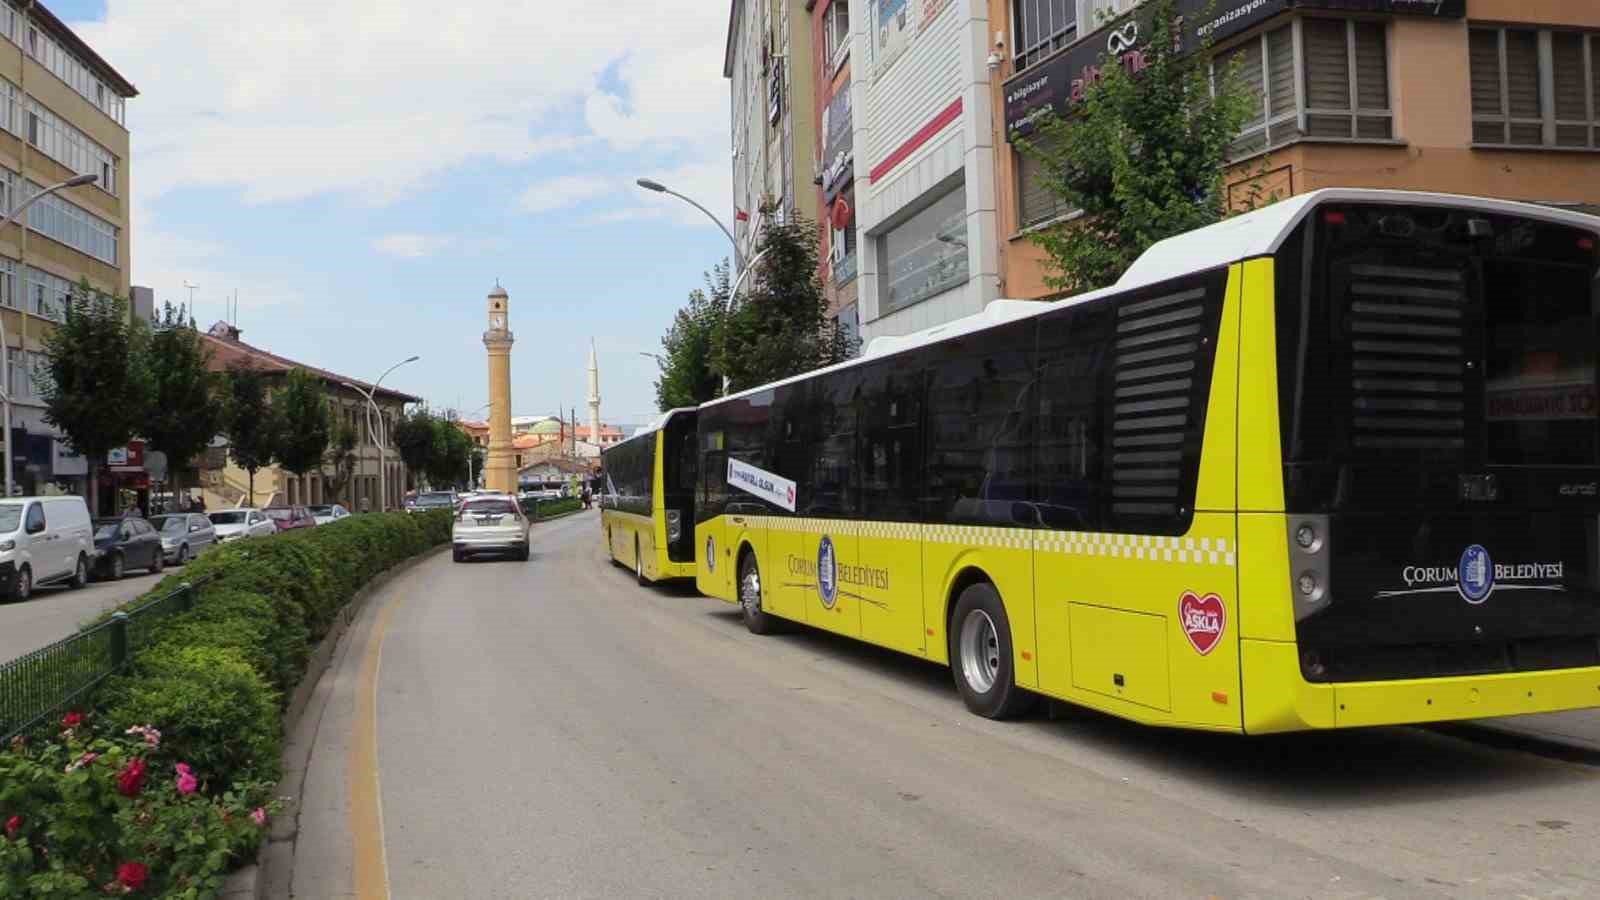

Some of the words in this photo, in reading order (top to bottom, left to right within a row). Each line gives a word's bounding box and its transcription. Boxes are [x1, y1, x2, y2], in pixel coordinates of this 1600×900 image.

[837, 562, 889, 591] BELEDİYESİ
[1402, 566, 1459, 588] ÇORUM
[1494, 561, 1564, 581] BELEDİYESİ
